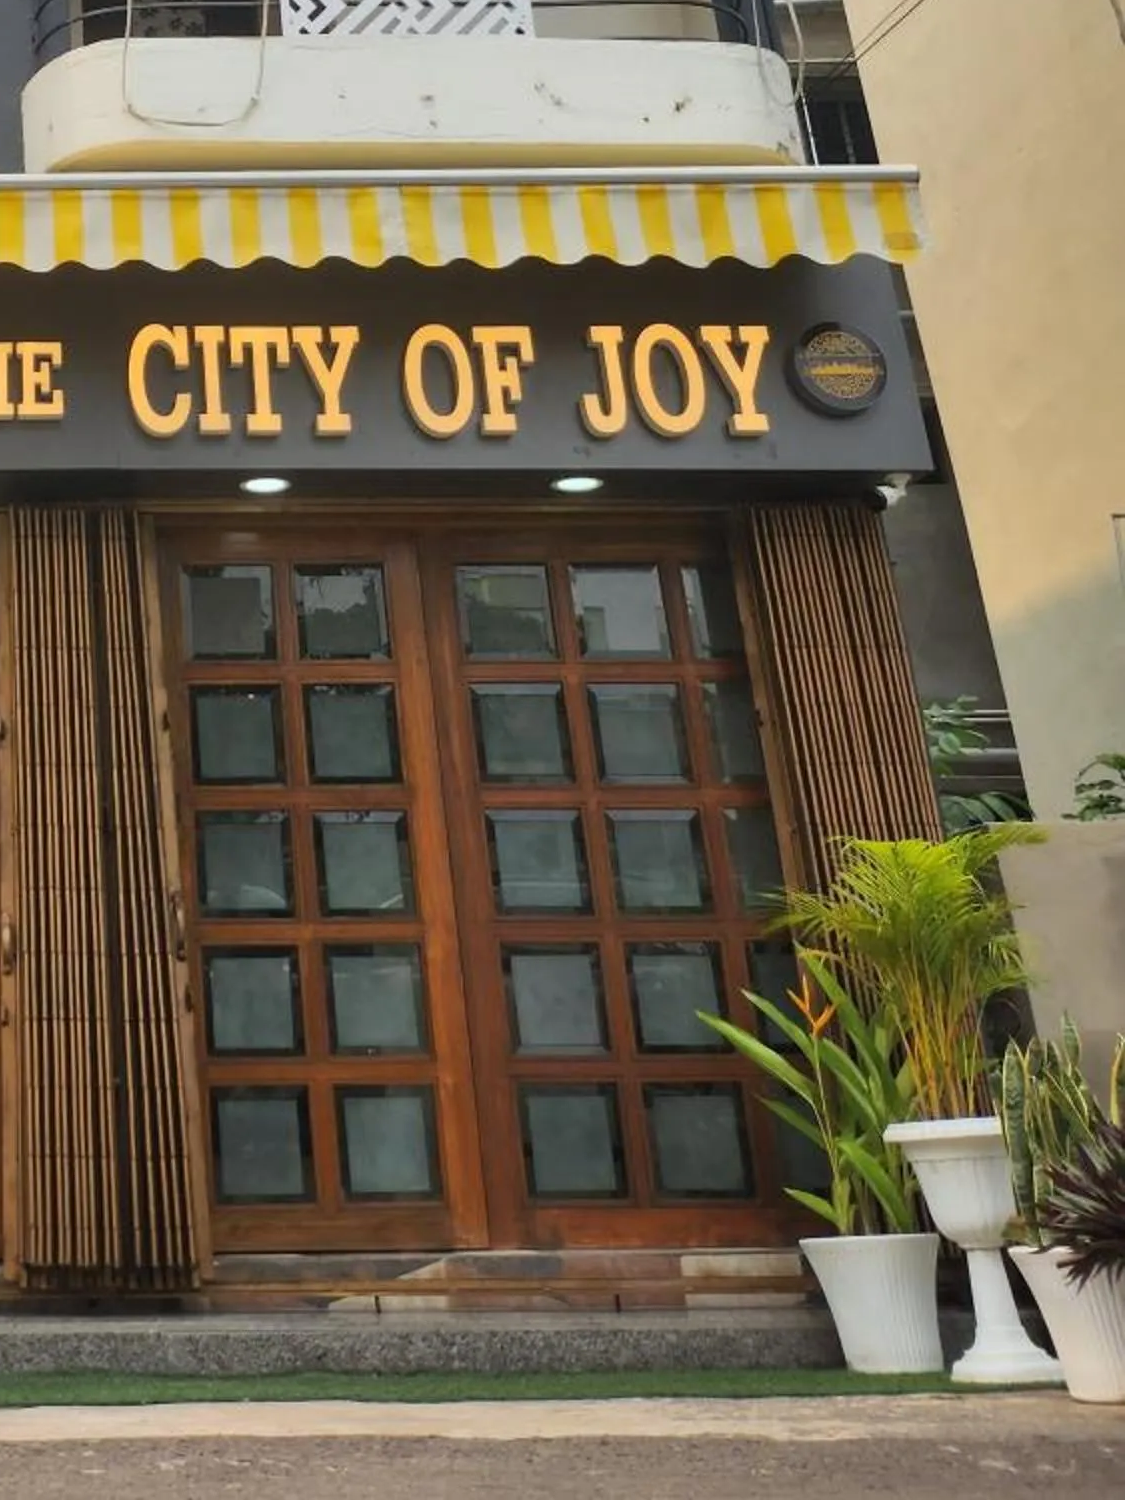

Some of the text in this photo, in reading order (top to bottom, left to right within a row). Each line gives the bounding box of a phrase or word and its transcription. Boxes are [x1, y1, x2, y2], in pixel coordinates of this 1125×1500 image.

[127, 323, 360, 438] CITY
[402, 323, 536, 439] OF
[579, 323, 770, 438] JOY
